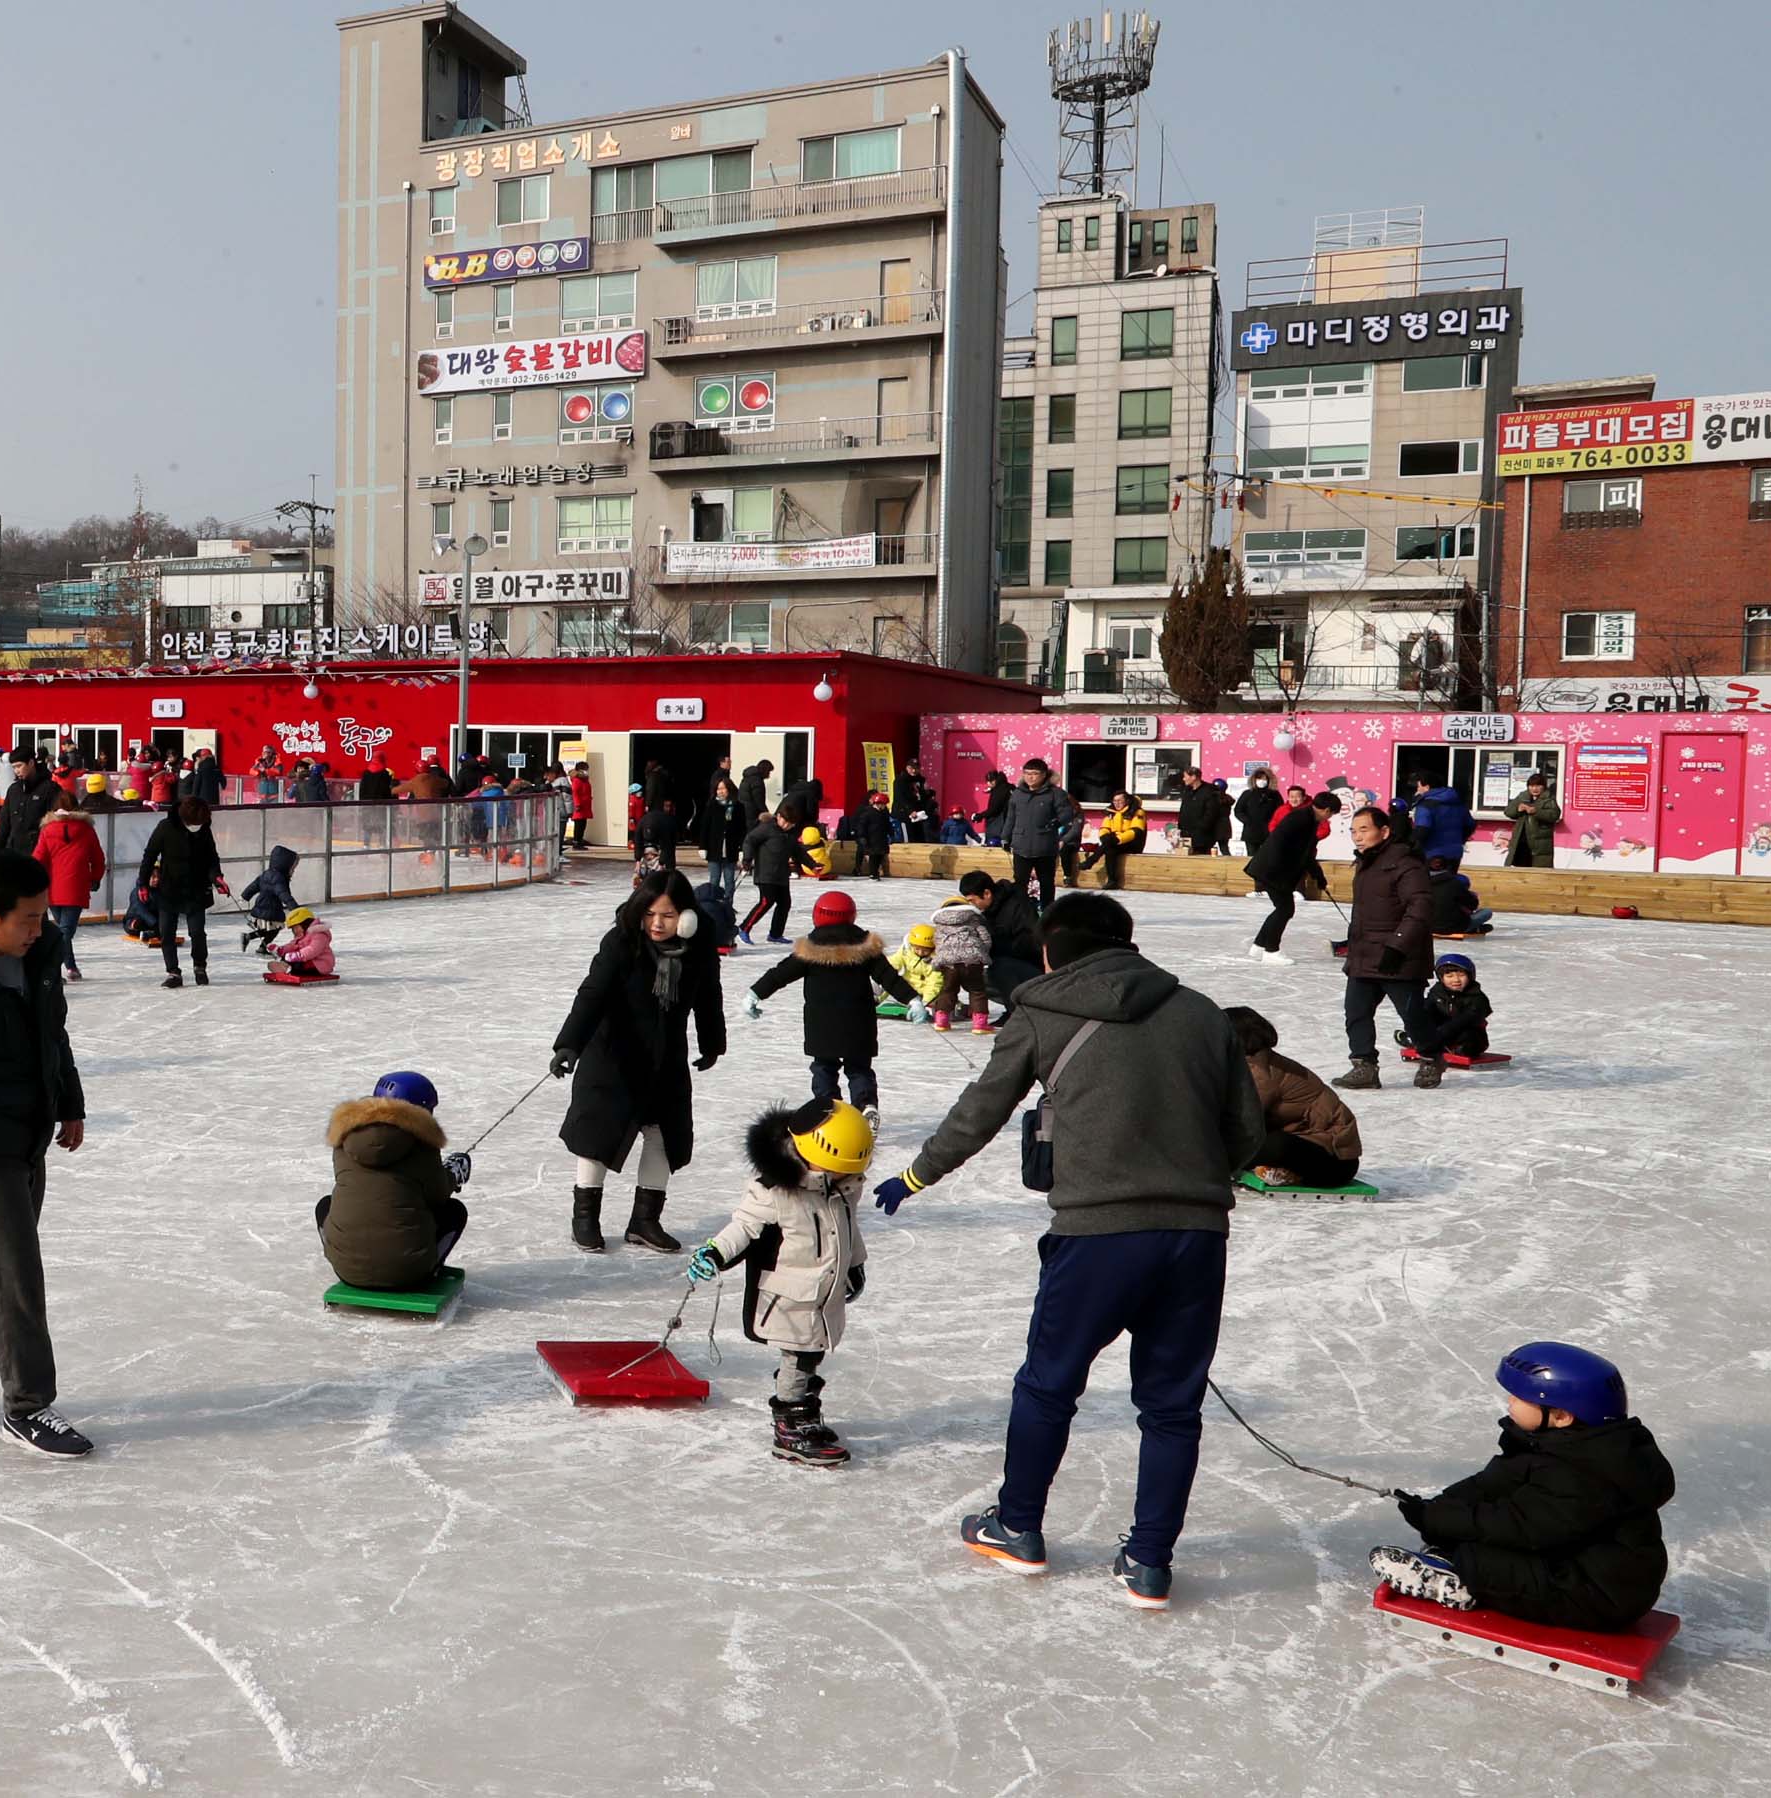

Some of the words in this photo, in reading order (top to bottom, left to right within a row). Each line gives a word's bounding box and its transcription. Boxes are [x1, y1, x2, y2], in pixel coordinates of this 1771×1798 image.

[435, 131, 621, 182] 광장직업소개소
[1286, 306, 1511, 346] 마디정형외과
[447, 348, 499, 375] 대왕
[503, 337, 612, 374] 숯불갈비
[1469, 338, 1497, 350] 의원
[512, 371, 578, 384] 032-766-1429
[1676, 401, 1692, 411] 3F
[1702, 401, 1736, 412] 국수가
[1739, 400, 1750, 410] 맛
[1503, 411, 1687, 450] 파출부대모집
[1503, 459, 1532, 471] 진선미
[1536, 457, 1565, 469] 파출부
[1570, 443, 1686, 468] 764-0033
[1608, 483, 1637, 508] 파
[501, 571, 622, 598] 아구·쭈꾸미
[160, 631, 207, 660] 인천
[212, 630, 258, 659] 동구
[267, 627, 341, 657] 화도진
[663, 704, 696, 716] 휴게실
[1726, 683, 1771, 713] 국
[1108, 726, 1148, 736] 대여·반납
[1109, 717, 1147, 726] 스케이트
[1450, 716, 1506, 727] 스케이트
[338, 717, 393, 761] 동구
[1447, 728, 1507, 741] 대여·반납
